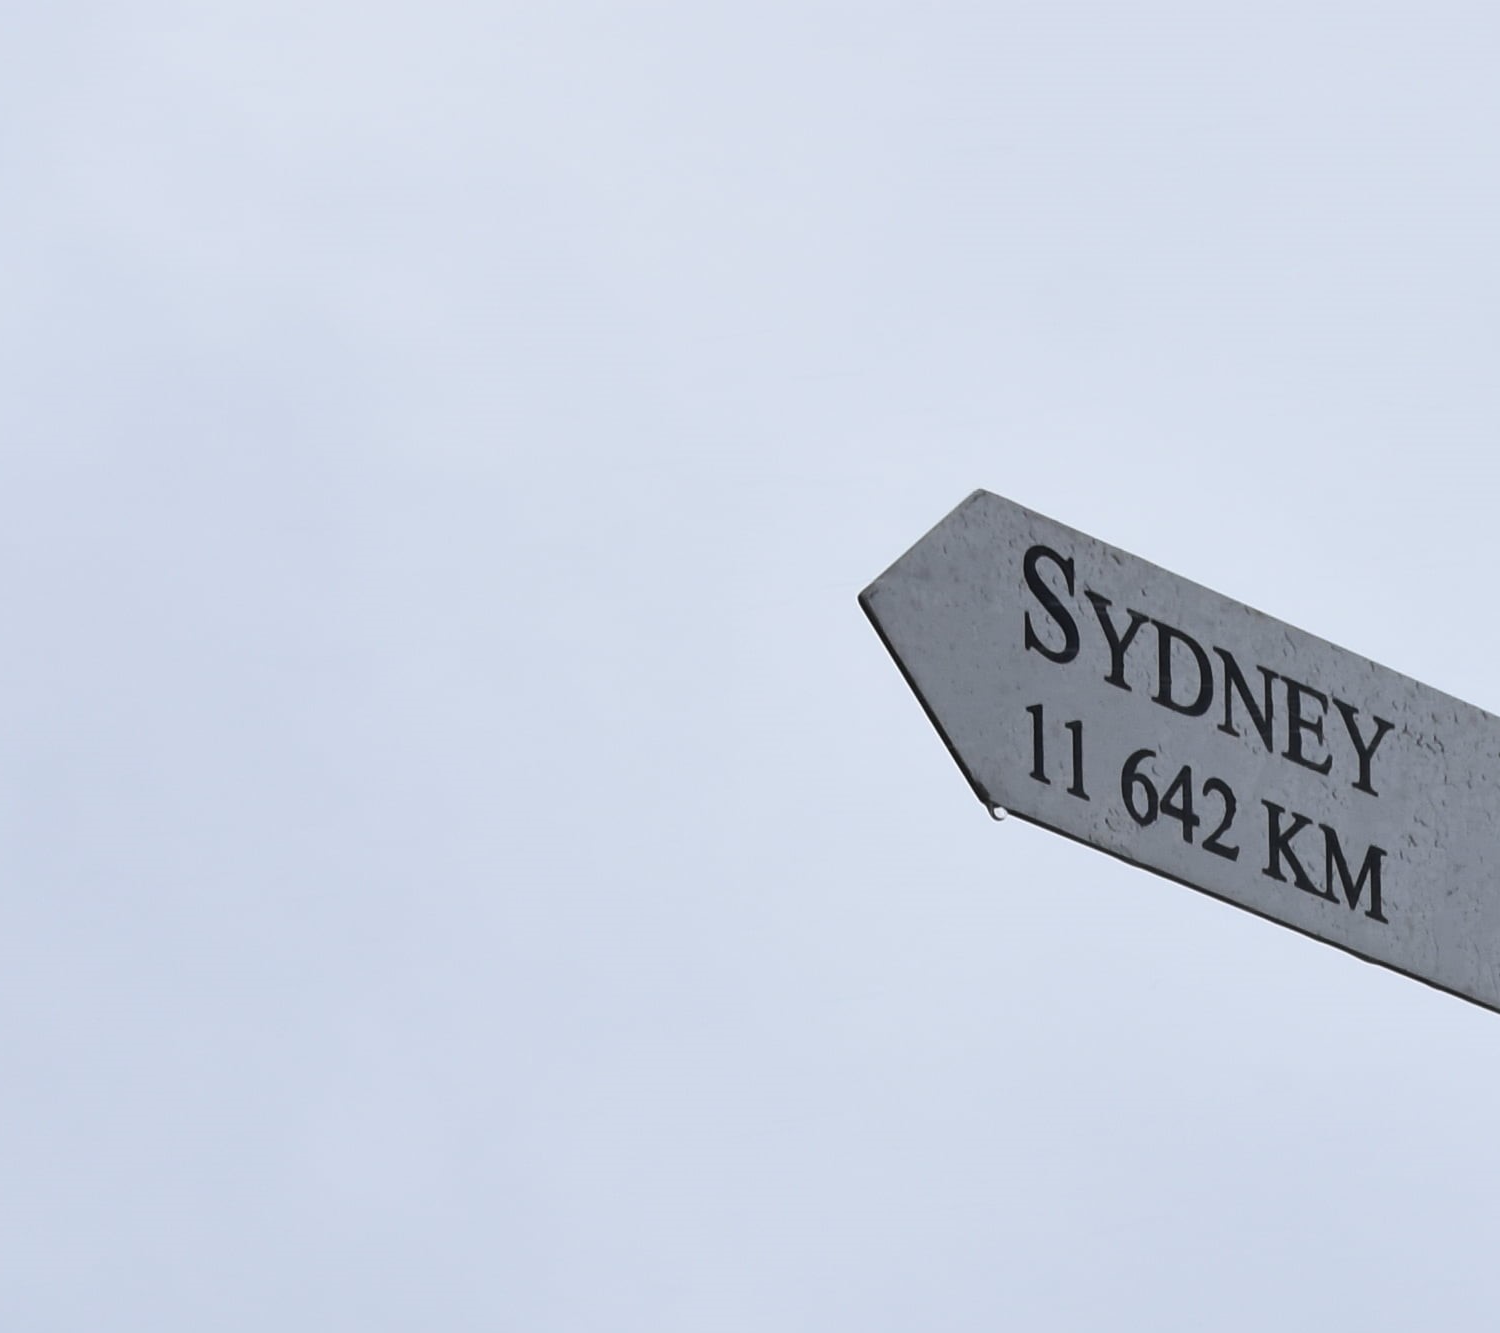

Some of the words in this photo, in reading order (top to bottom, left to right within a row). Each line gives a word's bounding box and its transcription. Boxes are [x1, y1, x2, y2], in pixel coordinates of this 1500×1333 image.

[1021, 543, 1396, 798] SYDNEY
[1024, 702, 1091, 803] 11
[1119, 747, 1241, 863] 642
[1260, 798, 1390, 926] KM
